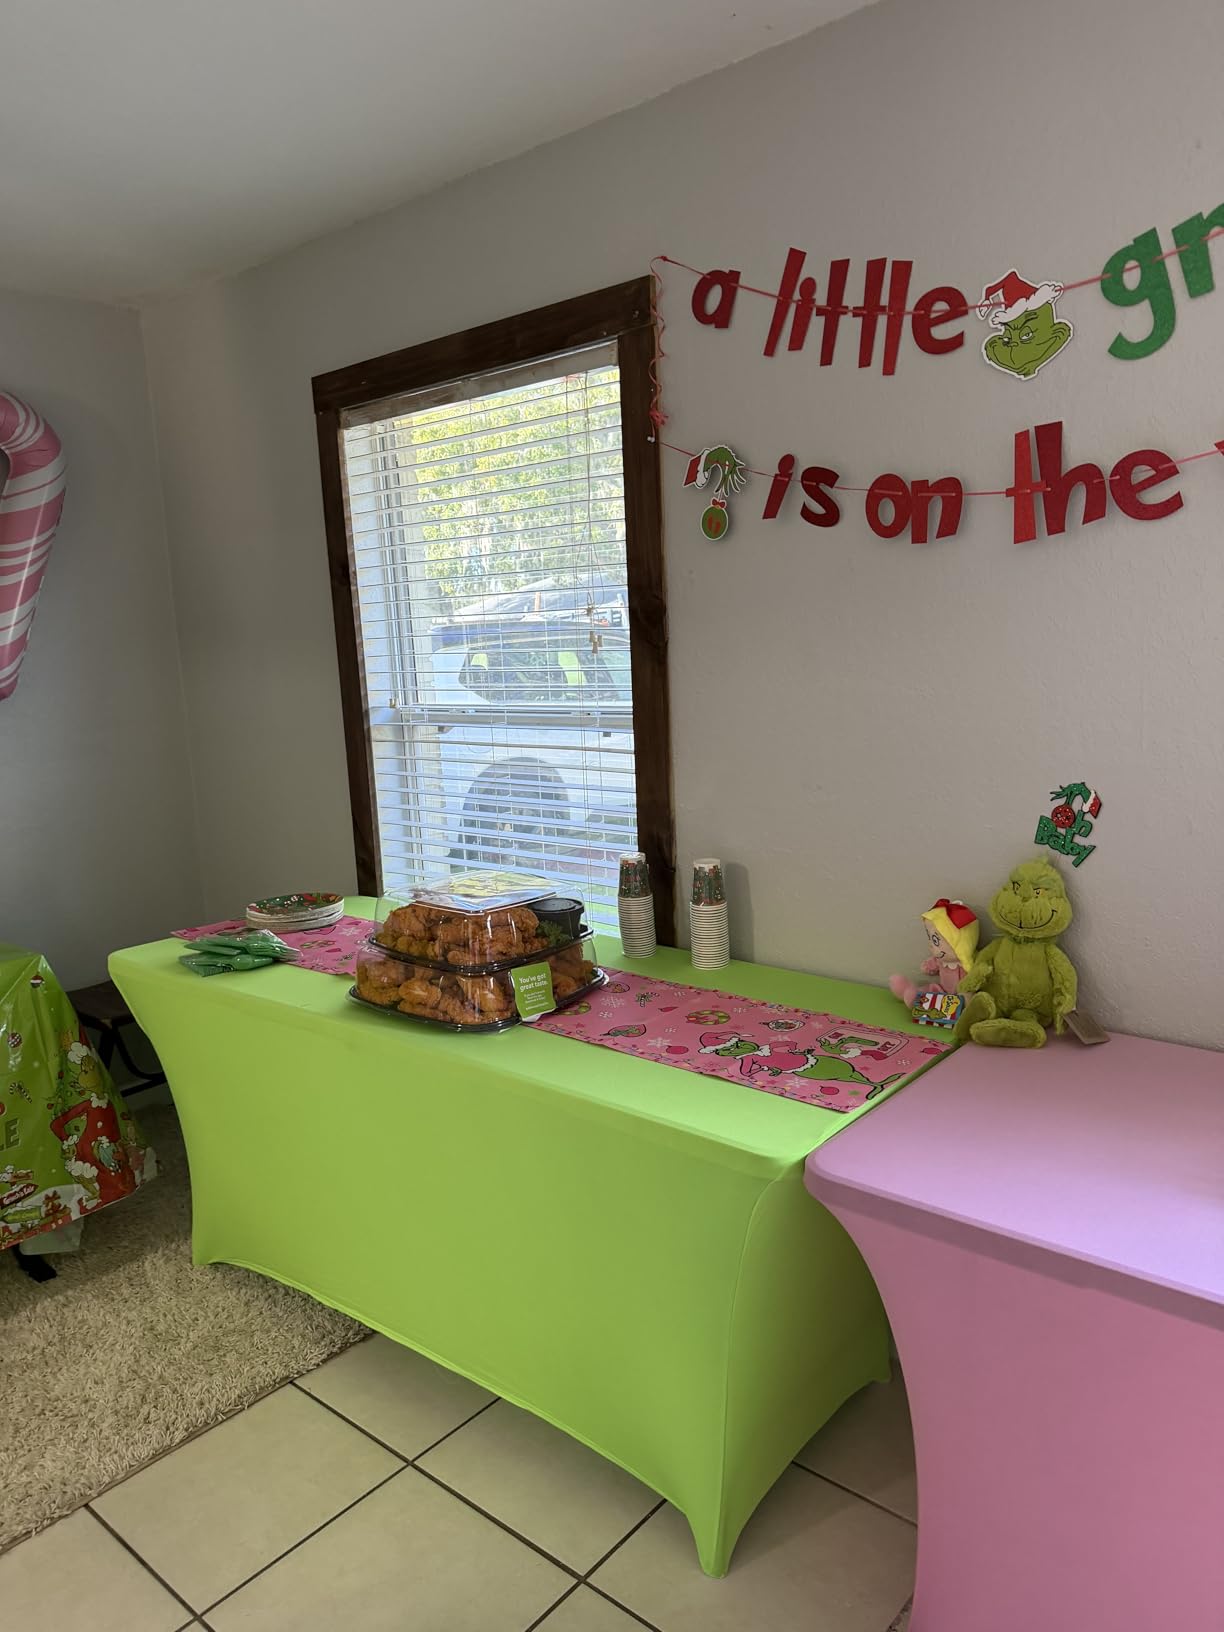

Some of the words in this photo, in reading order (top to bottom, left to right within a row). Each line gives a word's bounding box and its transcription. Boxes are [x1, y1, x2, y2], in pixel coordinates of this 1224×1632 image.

[691, 268, 741, 329] a
[763, 247, 969, 376] little
[762, 453, 841, 528] is
[865, 473, 963, 545] on
[1005, 421, 1185, 545] the
[1034, 814, 1096, 868] Baby
